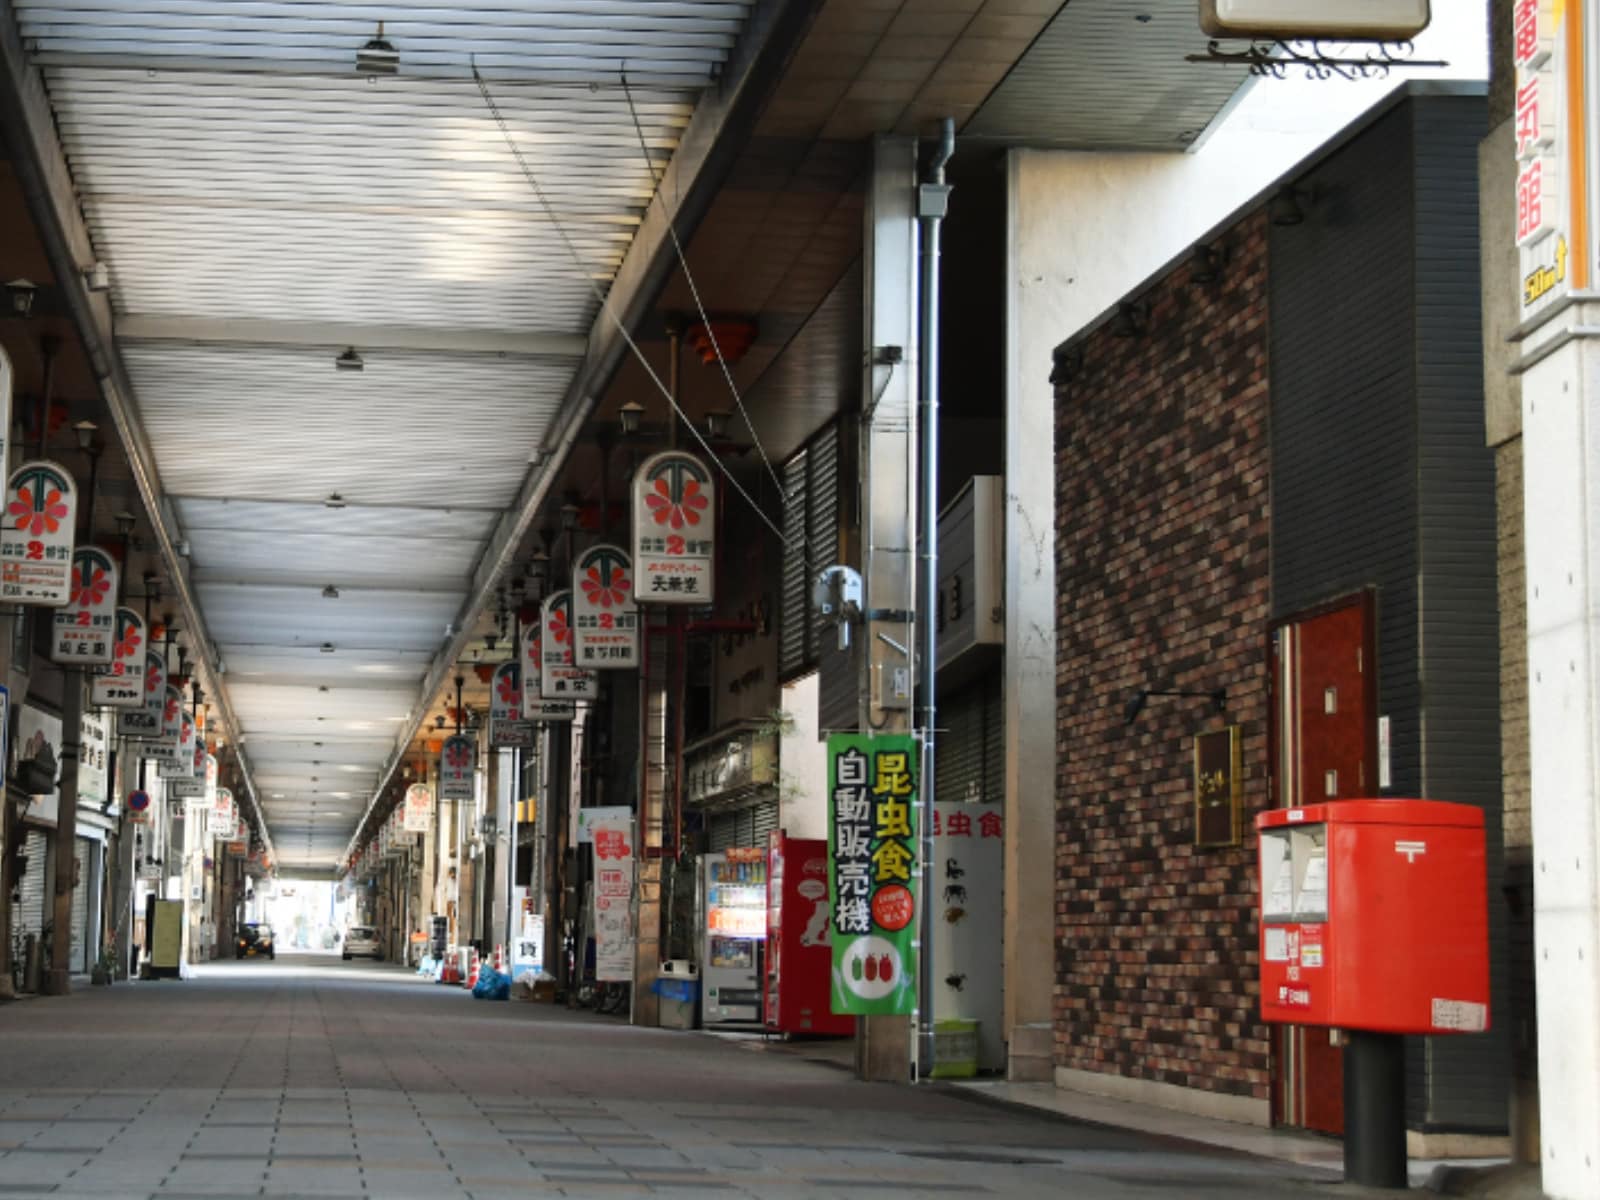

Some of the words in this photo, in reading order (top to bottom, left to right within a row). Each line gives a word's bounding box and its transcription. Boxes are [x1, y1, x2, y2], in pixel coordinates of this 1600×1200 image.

[835, 749, 871, 932] 自動販売機
[872, 753, 912, 882] 昆虫食
